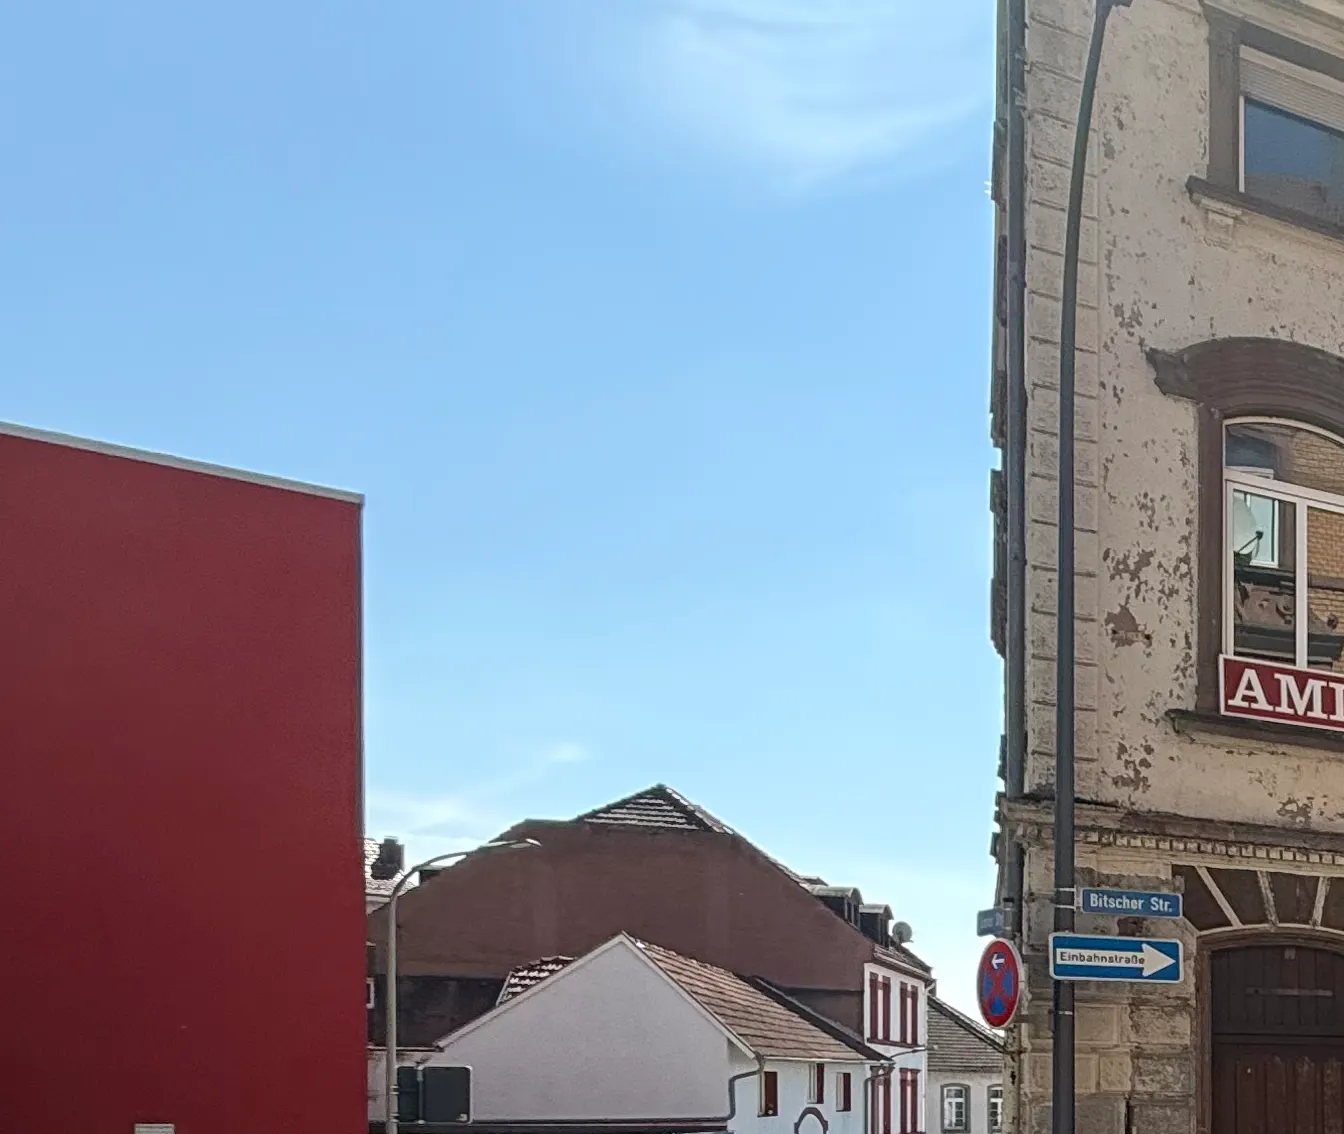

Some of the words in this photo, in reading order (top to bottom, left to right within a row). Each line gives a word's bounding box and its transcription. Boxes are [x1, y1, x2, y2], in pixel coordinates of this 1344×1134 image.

[1089, 893, 1144, 911] Bitscher
[1149, 897, 1174, 913] Str.
[1059, 951, 1146, 966] Einbahnstraße
